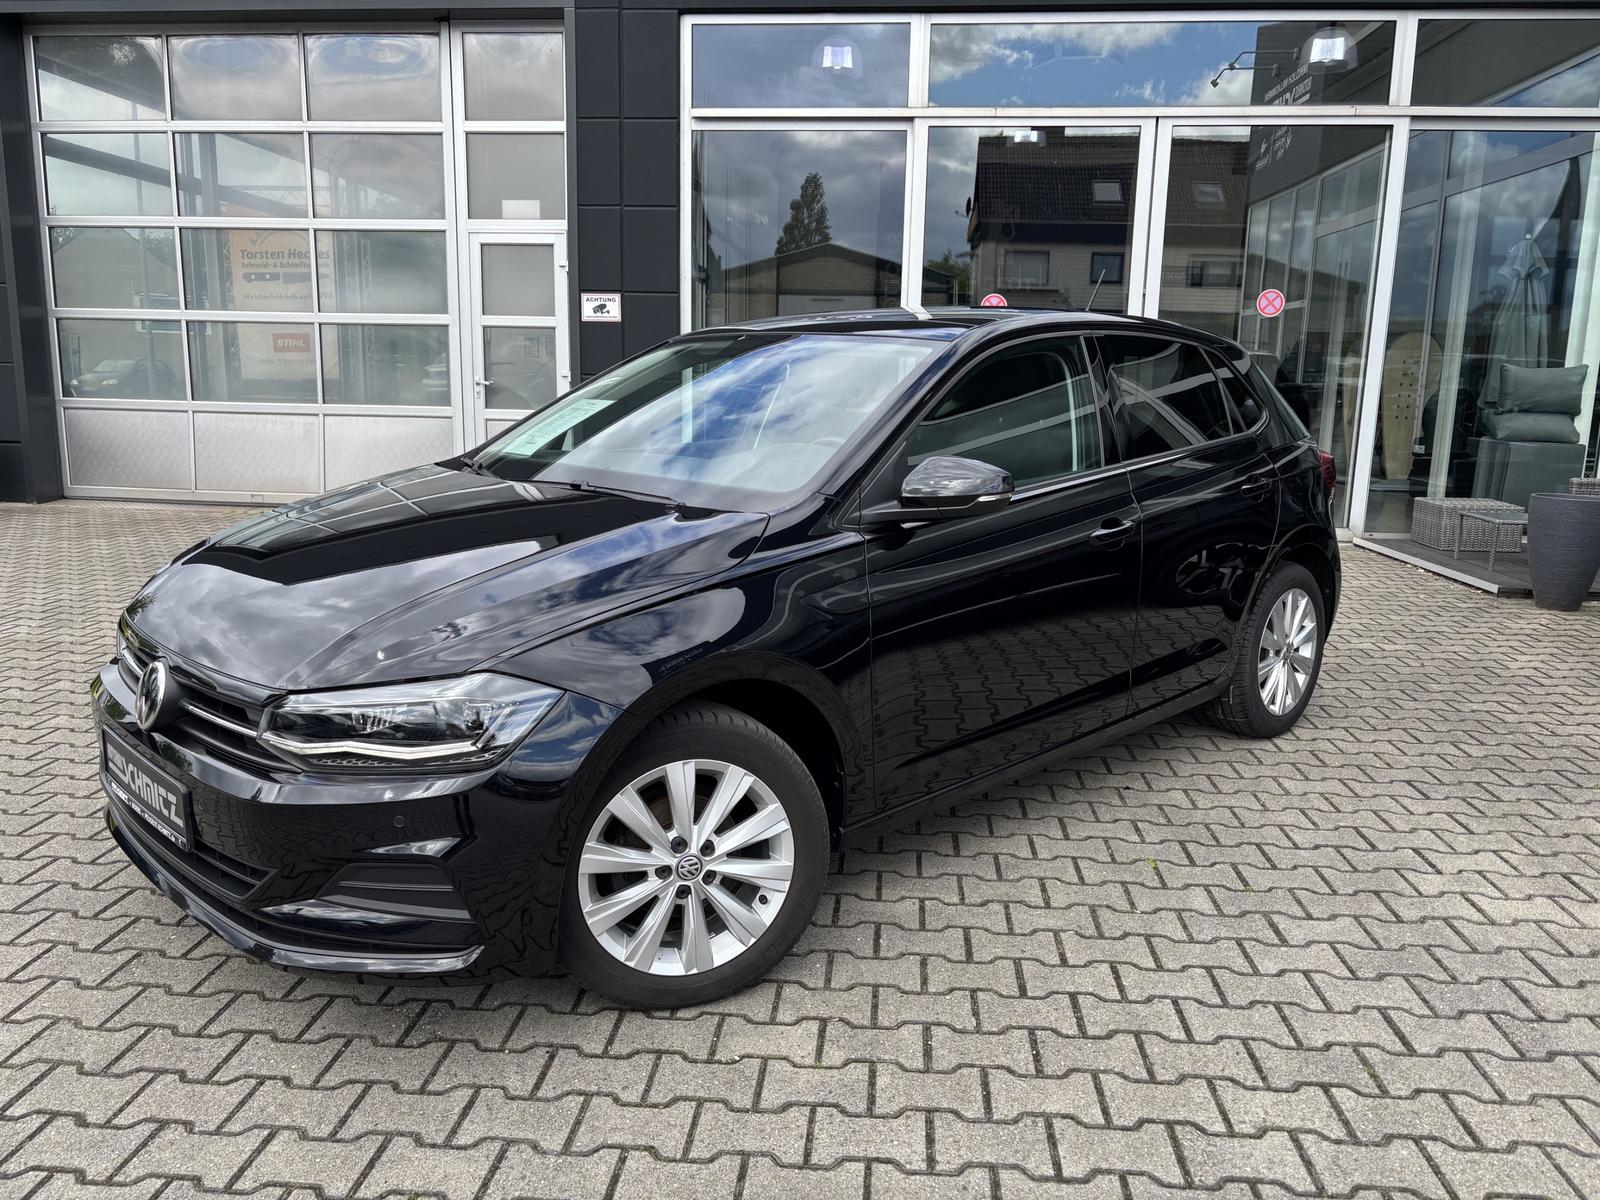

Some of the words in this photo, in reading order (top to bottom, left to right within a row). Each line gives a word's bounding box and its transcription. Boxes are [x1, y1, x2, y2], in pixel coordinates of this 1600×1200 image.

[240, 248, 285, 260] Torsten
[287, 248, 330, 260] Heces
[276, 339, 307, 347] STIHL
[108, 757, 184, 828] SCHMITZ
